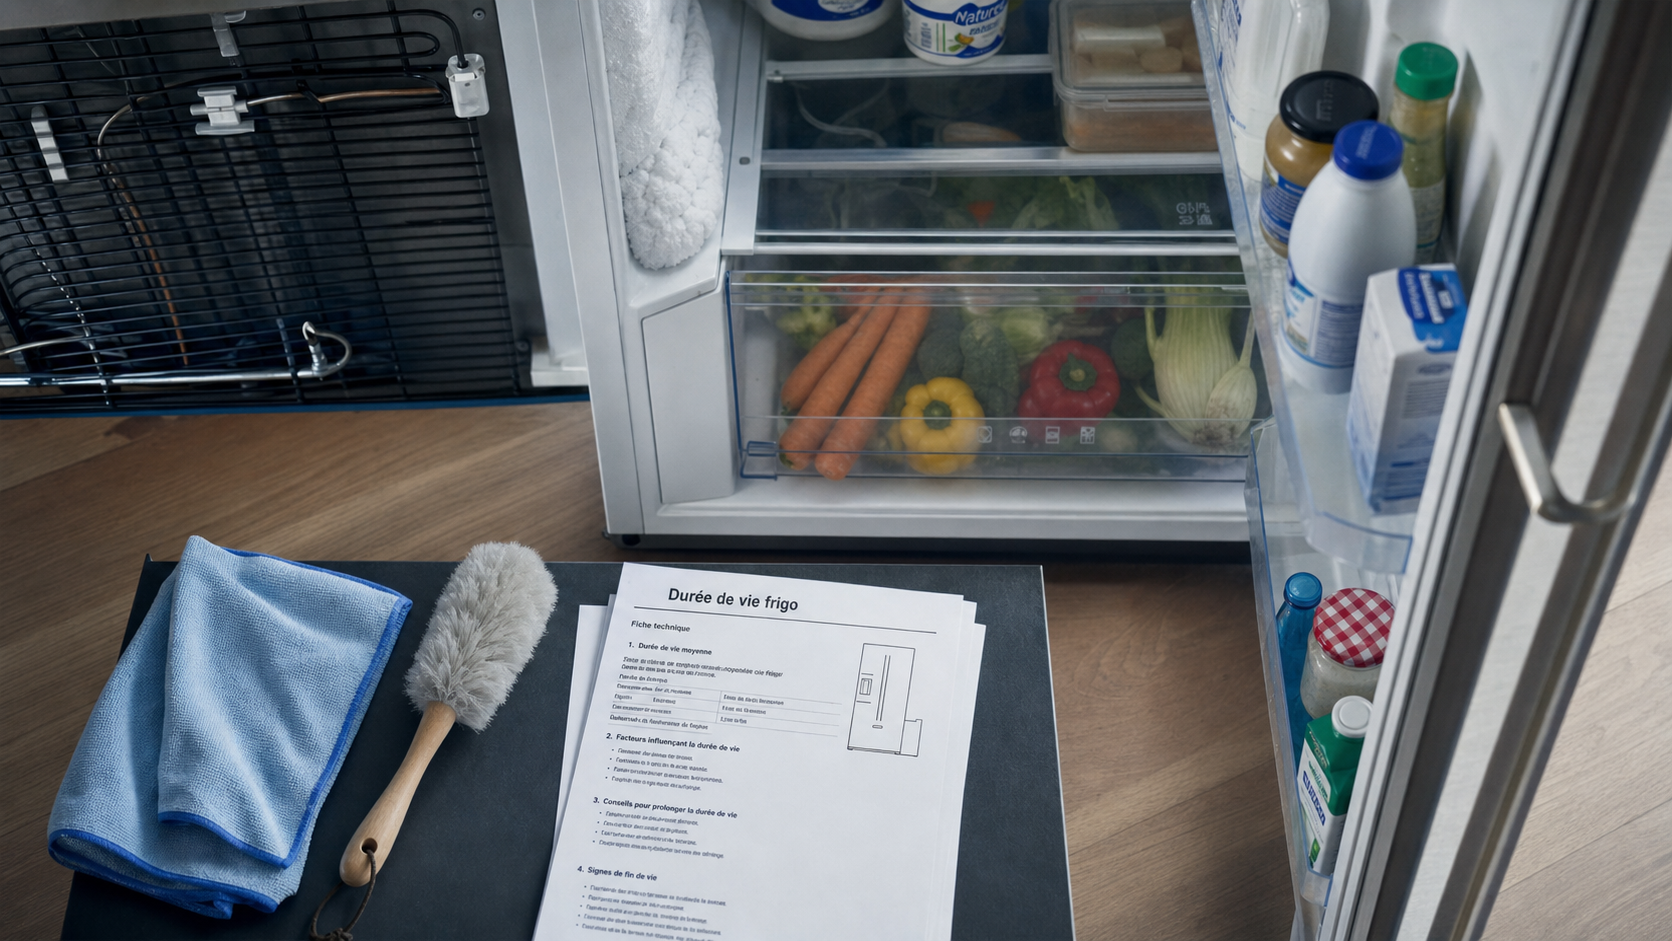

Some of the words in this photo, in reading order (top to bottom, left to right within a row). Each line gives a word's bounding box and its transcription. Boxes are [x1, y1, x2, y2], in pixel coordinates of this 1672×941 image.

[667, 587, 713, 604] Durée
[716, 591, 735, 606] de
[739, 594, 761, 608] vie
[764, 595, 799, 614] frigo
[630, 620, 652, 629] Fiche
[653, 622, 691, 633] technique
[638, 642, 659, 651] Durée
[659, 644, 669, 652] de
[669, 645, 681, 653] vie
[681, 647, 713, 656] moyenne
[615, 733, 647, 743] Facteurs
[647, 736, 688, 748] influençant
[688, 740, 696, 748] la
[696, 742, 718, 750] durée
[718, 744, 729, 752] de
[729, 745, 741, 753] vie
[602, 797, 634, 808] Conseils
[633, 802, 652, 810] pour
[651, 804, 687, 814] prolonger
[695, 807, 716, 816] durée
[727, 811, 738, 819] vie
[587, 866, 613, 876] Signes
[613, 869, 624, 878] de
[624, 870, 635, 879] fin
[635, 872, 646, 880] de
[646, 873, 658, 882] vie
